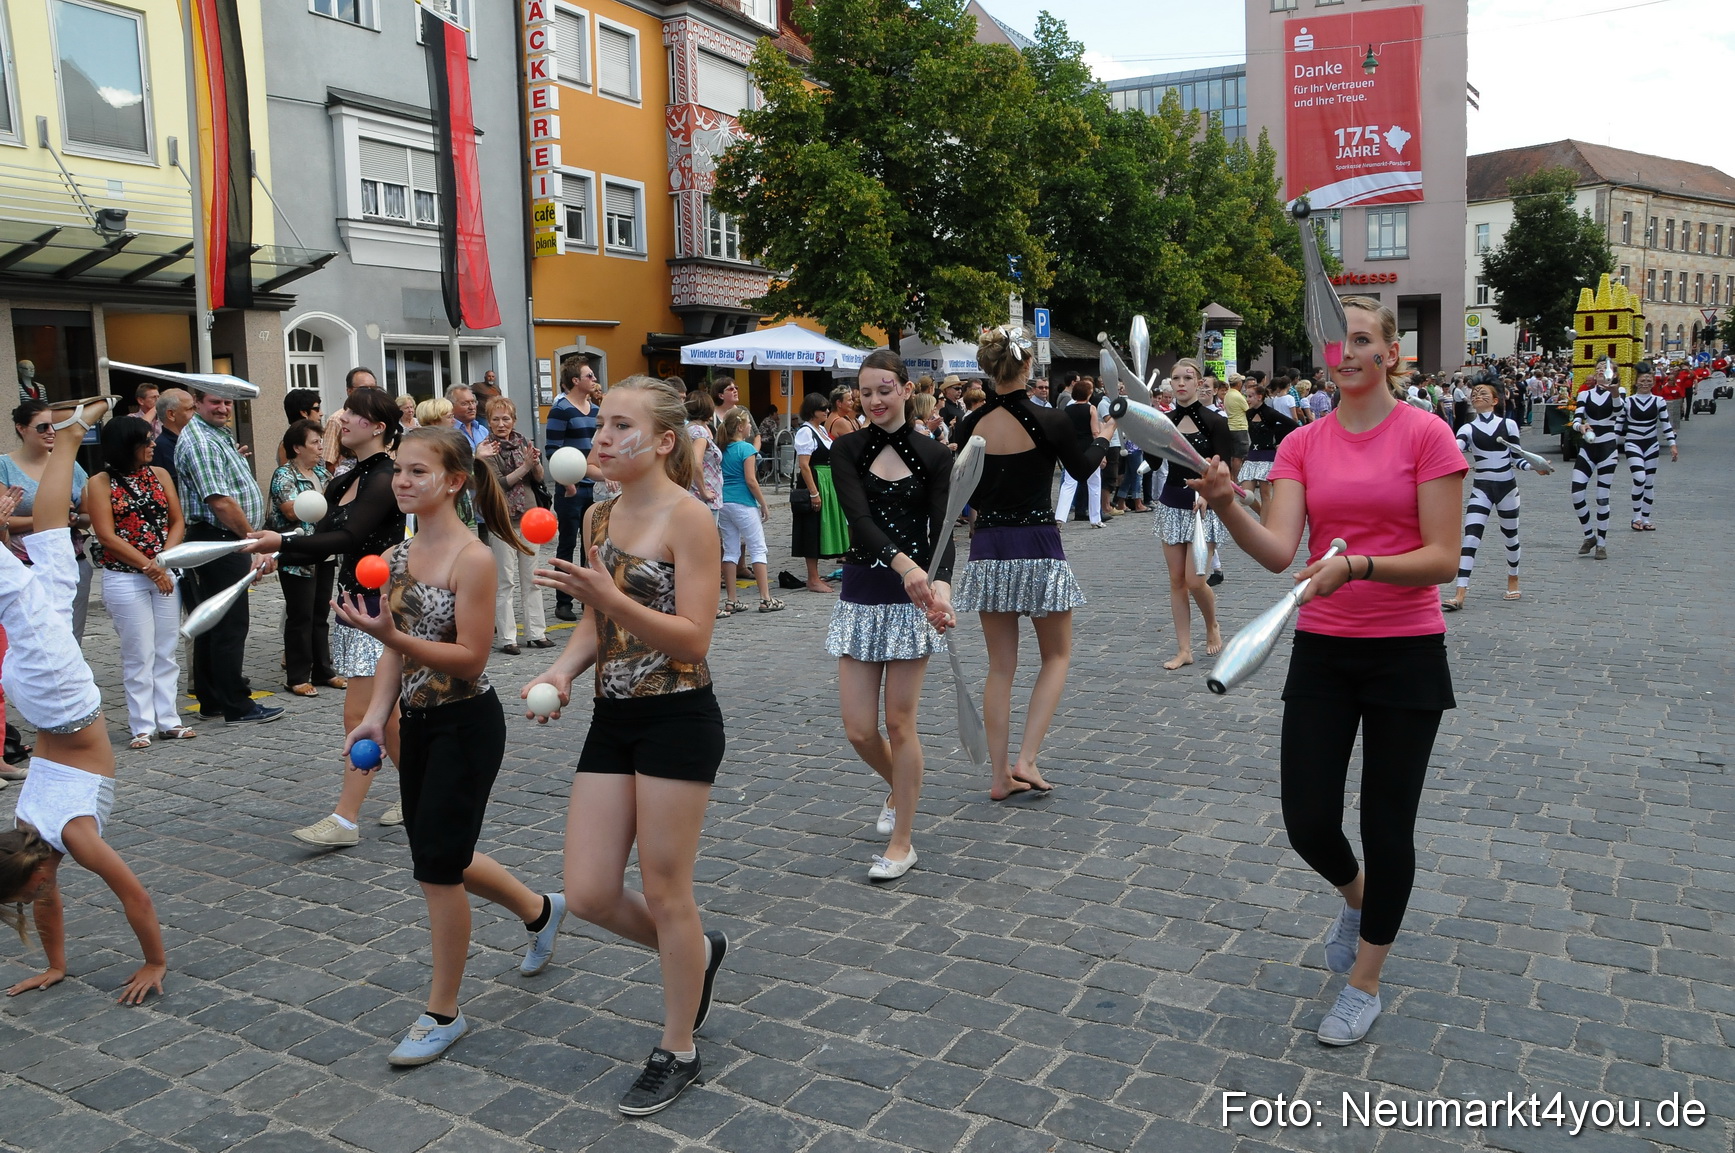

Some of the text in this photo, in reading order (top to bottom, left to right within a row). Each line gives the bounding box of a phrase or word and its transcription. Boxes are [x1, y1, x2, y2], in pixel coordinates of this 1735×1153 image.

[1294, 61, 1343, 79] Danke
[1294, 79, 1375, 95] für Ihr Vertrauen
[1294, 93, 1368, 108] und Ihre Treue.
[1334, 125, 1381, 147] 175
[1335, 144, 1381, 159] JAHRE
[1335, 163, 1361, 171] Sparkasse
[534, 205, 556, 222] café
[1328, 271, 1398, 286] arkasse
[1038, 312, 1047, 335] P
[258, 330, 270, 341] 47
[690, 349, 735, 359] Winkler Bräu
[765, 350, 815, 361] Winkler Bräu
[917, 358, 931, 368] Bräu
[948, 359, 978, 368] Winkler Bräu
